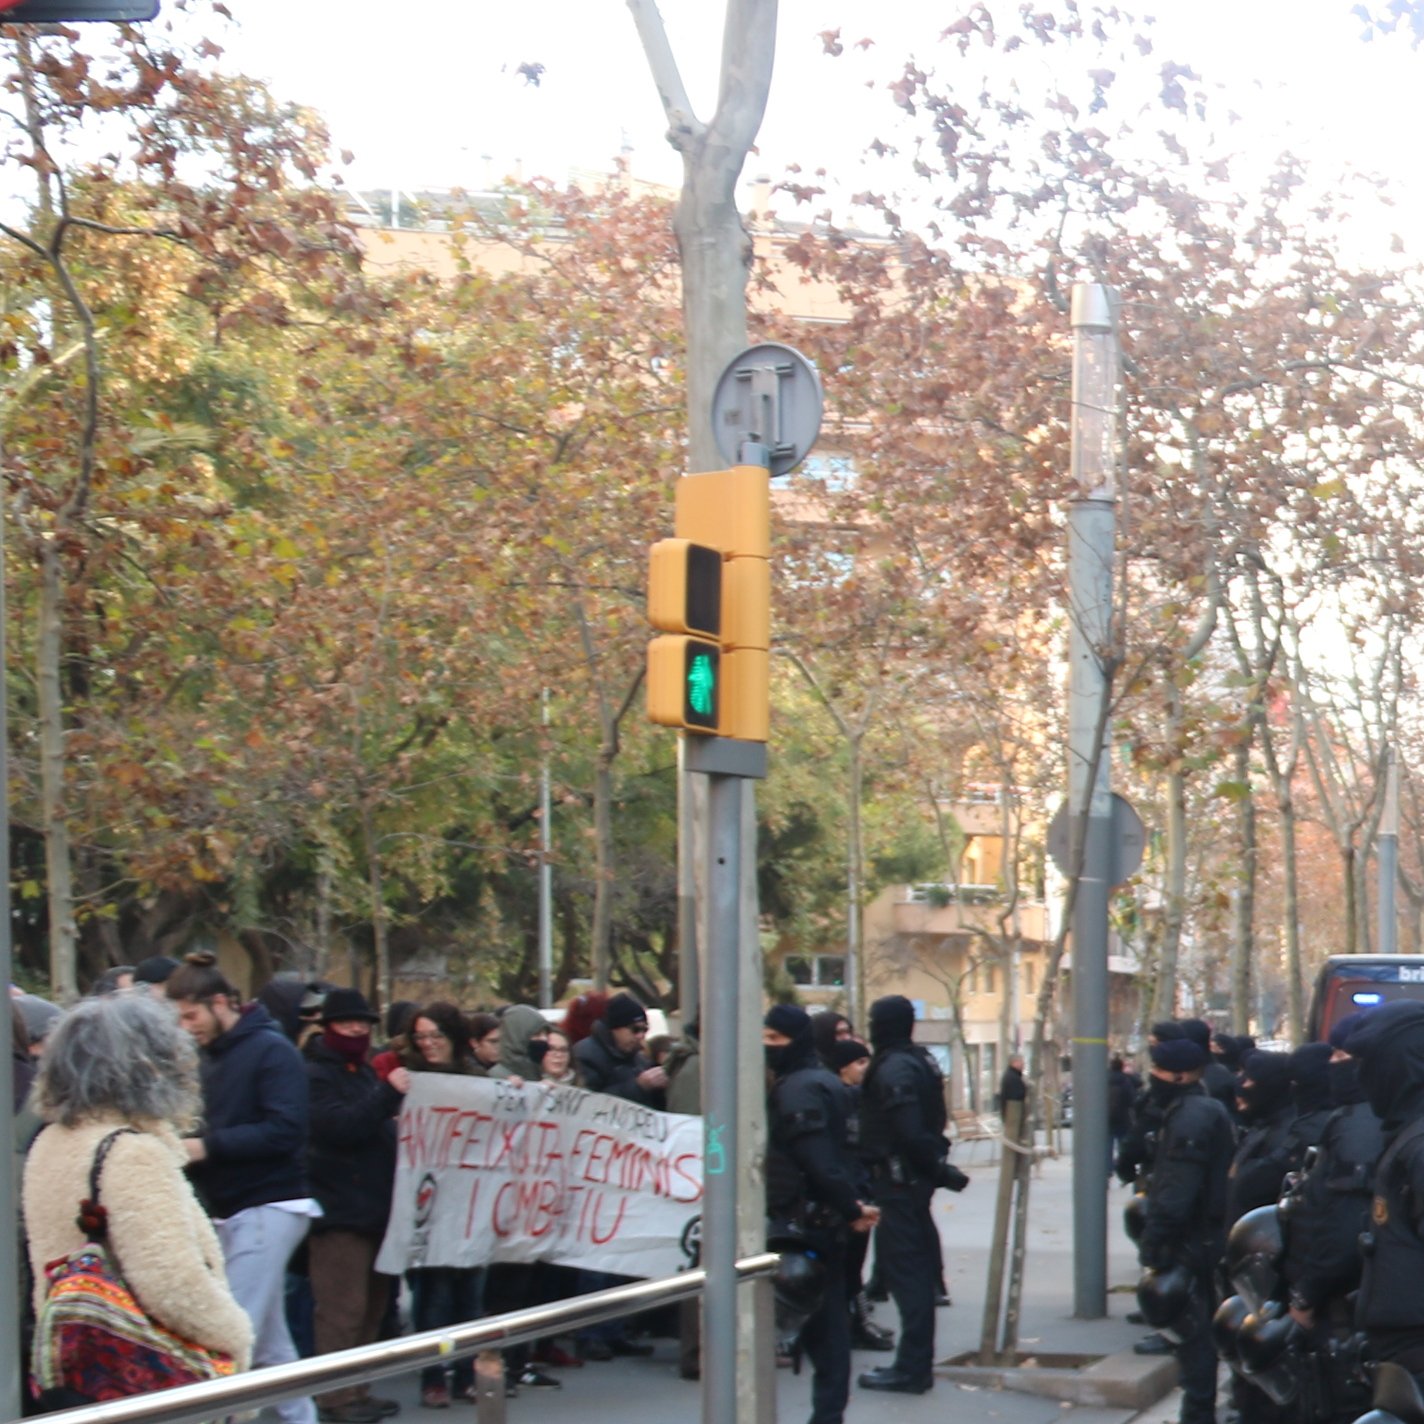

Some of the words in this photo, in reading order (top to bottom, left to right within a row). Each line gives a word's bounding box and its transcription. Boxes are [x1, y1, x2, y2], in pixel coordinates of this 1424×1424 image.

[592, 1098, 669, 1143] ANDREU
[571, 1129, 705, 1203] FEMINIS
[464, 1177, 480, 1240] I
